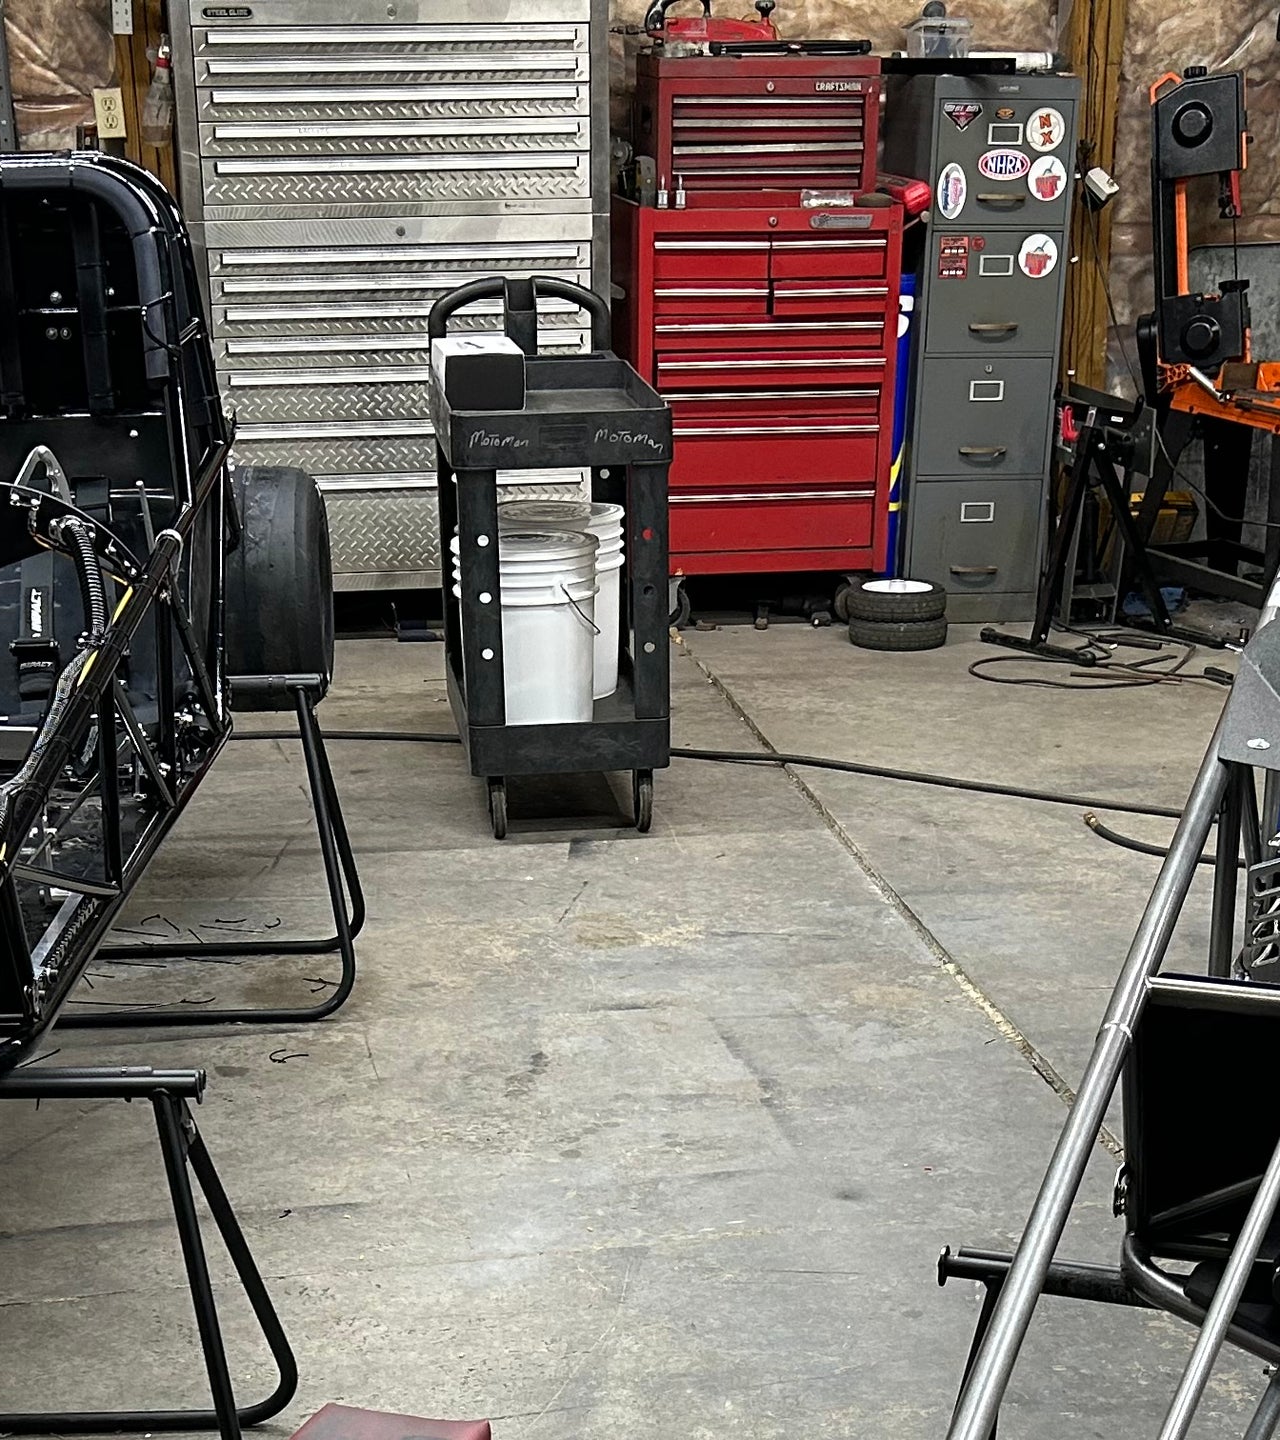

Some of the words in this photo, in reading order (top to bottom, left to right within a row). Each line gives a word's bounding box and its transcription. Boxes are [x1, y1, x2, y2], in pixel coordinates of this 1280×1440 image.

[815, 82, 862, 92] CRAFTSMAN
[986, 154, 1024, 175] NHRA
[30, 588, 43, 638] IMPACT
